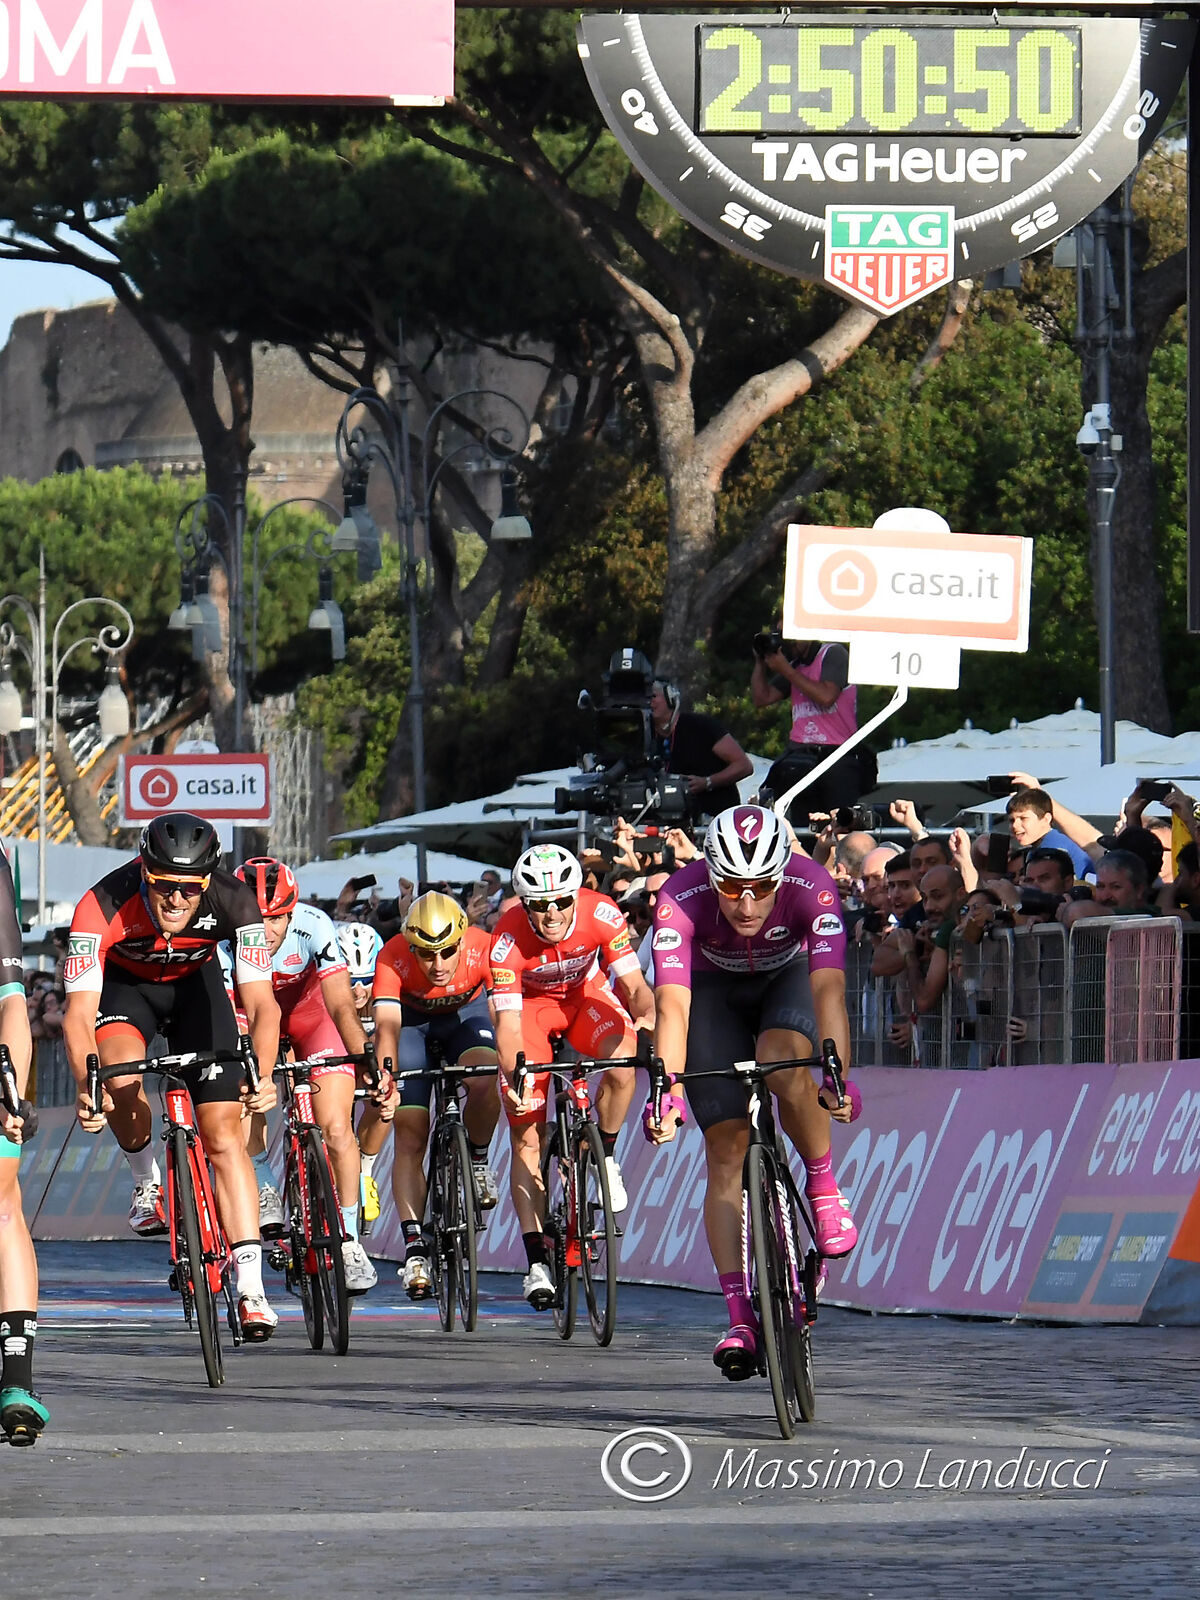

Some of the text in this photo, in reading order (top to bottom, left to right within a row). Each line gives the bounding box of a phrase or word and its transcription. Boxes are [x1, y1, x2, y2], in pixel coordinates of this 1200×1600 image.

[705, 28, 1074, 131] 2:50:50
[837, 213, 942, 246] TAG
[833, 253, 948, 305] HEUER
[891, 568, 1000, 600] casa.it
[891, 652, 922, 676] 10
[186, 774, 257, 796] casa.it
[69, 940, 92, 955] AG
[64, 956, 93, 980] EUER
[1087, 1067, 1172, 1176] enel
[928, 1083, 1090, 1295] enel
